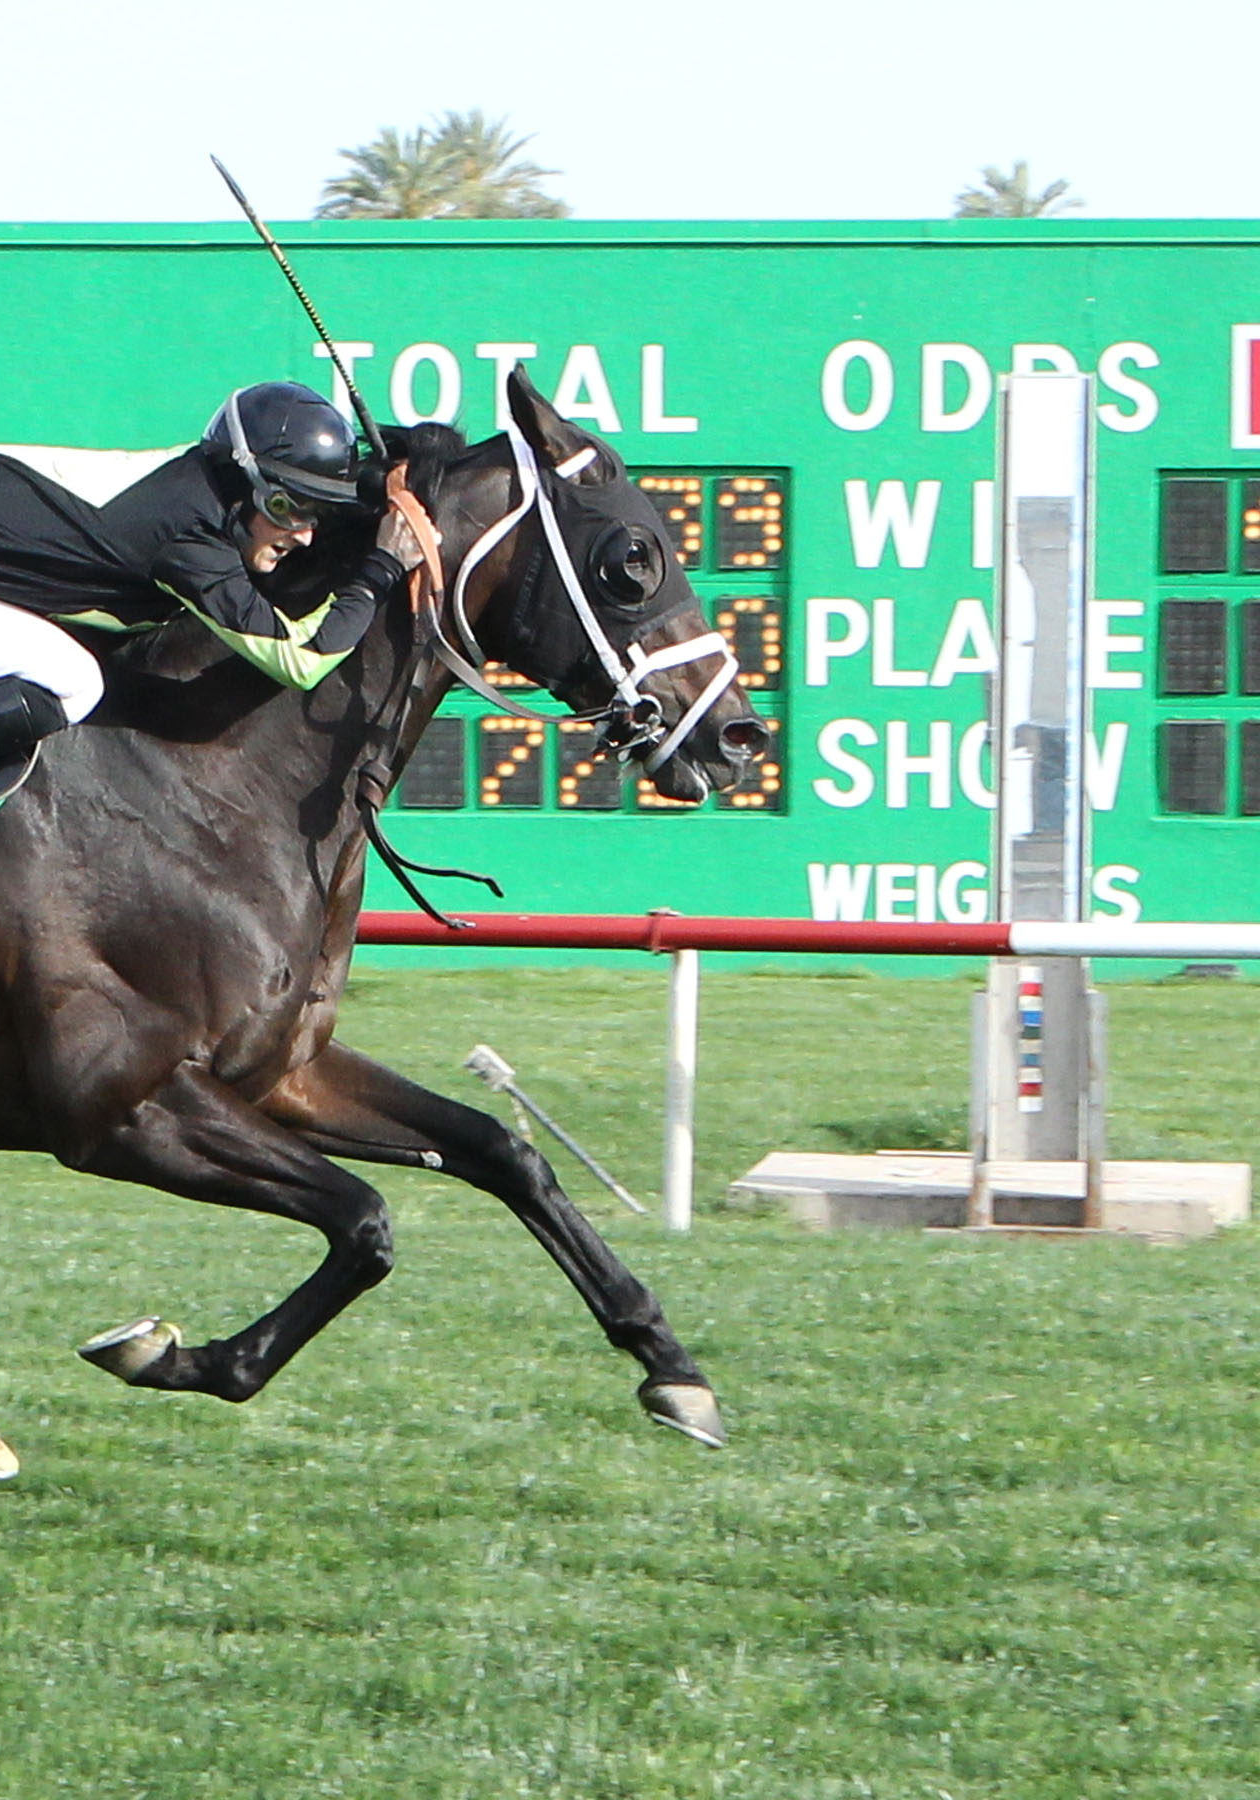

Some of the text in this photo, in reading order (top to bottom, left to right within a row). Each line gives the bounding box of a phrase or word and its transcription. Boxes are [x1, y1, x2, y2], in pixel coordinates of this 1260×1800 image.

[313, 341, 698, 433] TOTAL
[805, 598, 1144, 689] PLAE
[807, 861, 1142, 924] WEIGS
